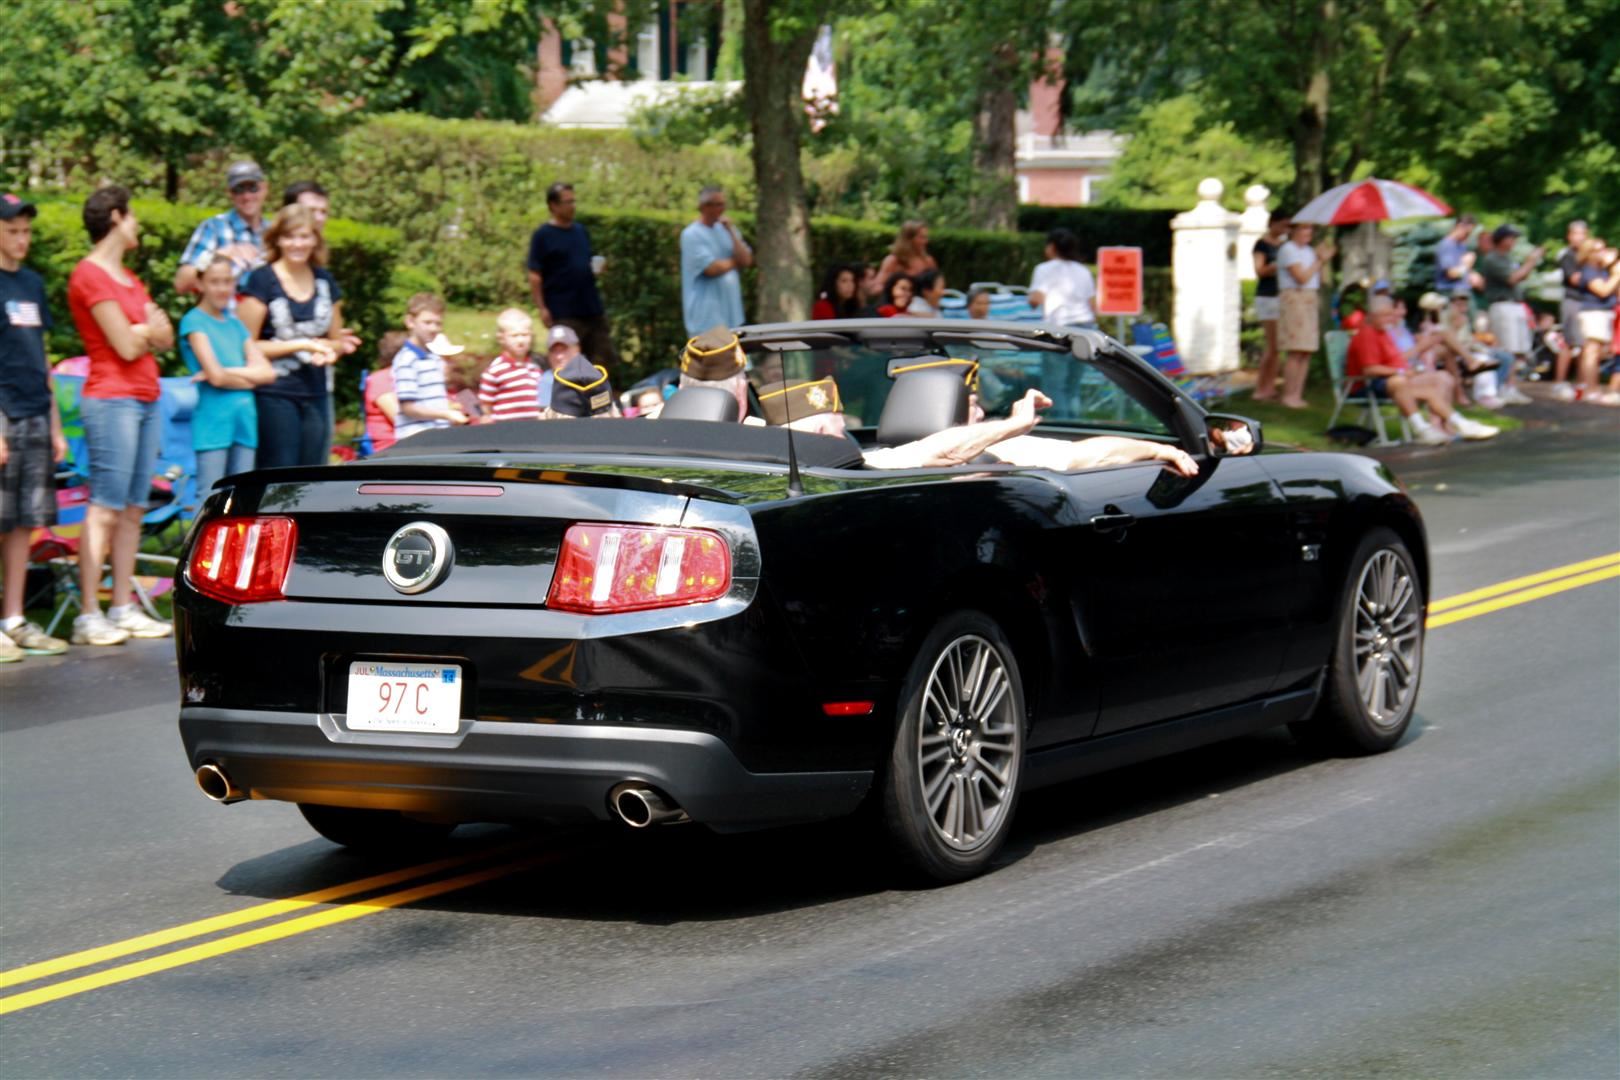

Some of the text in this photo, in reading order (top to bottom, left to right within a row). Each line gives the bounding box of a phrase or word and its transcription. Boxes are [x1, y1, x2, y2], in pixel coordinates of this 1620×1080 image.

[395, 549, 431, 565] GT
[355, 666, 436, 678] JUL Massachusetts
[379, 682, 430, 715] 97 C
